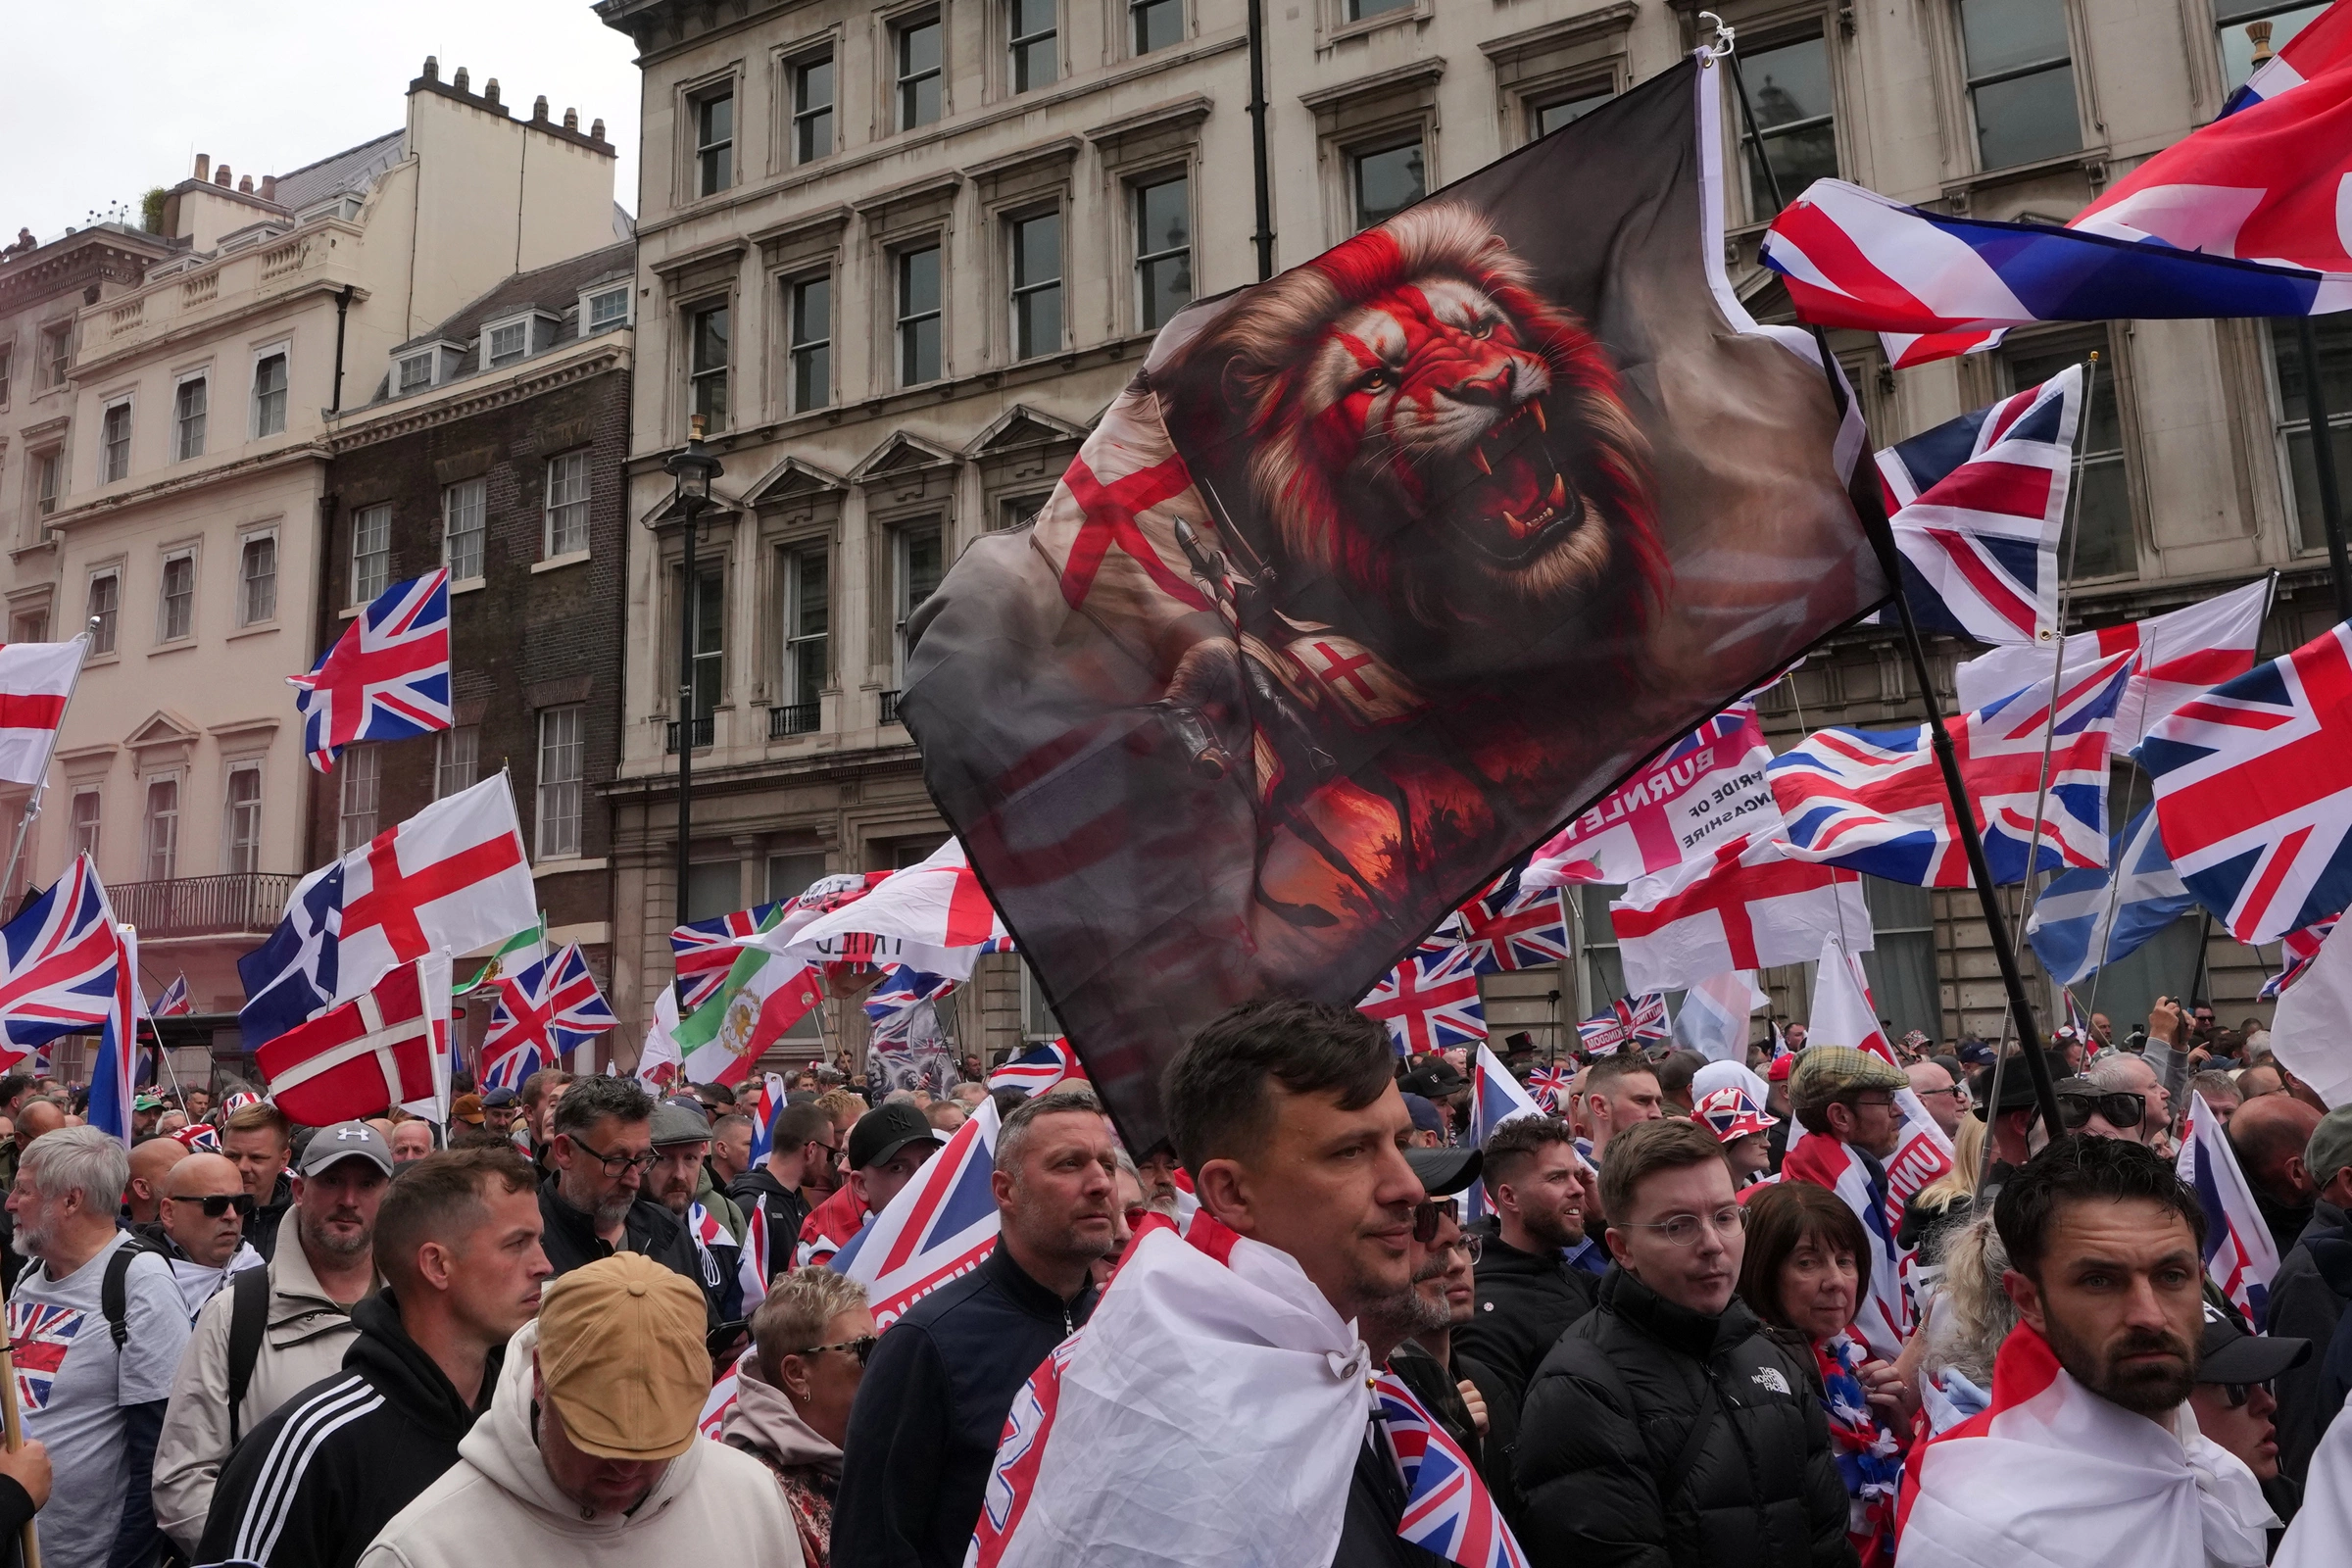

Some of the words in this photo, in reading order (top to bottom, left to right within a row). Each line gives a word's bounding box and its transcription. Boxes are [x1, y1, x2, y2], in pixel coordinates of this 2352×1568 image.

[887, 1108, 912, 1132] NY
[1757, 1366, 1775, 1376] THE
[1750, 1374, 1778, 1384] NORTH
[1763, 1382, 1784, 1393] FACE
